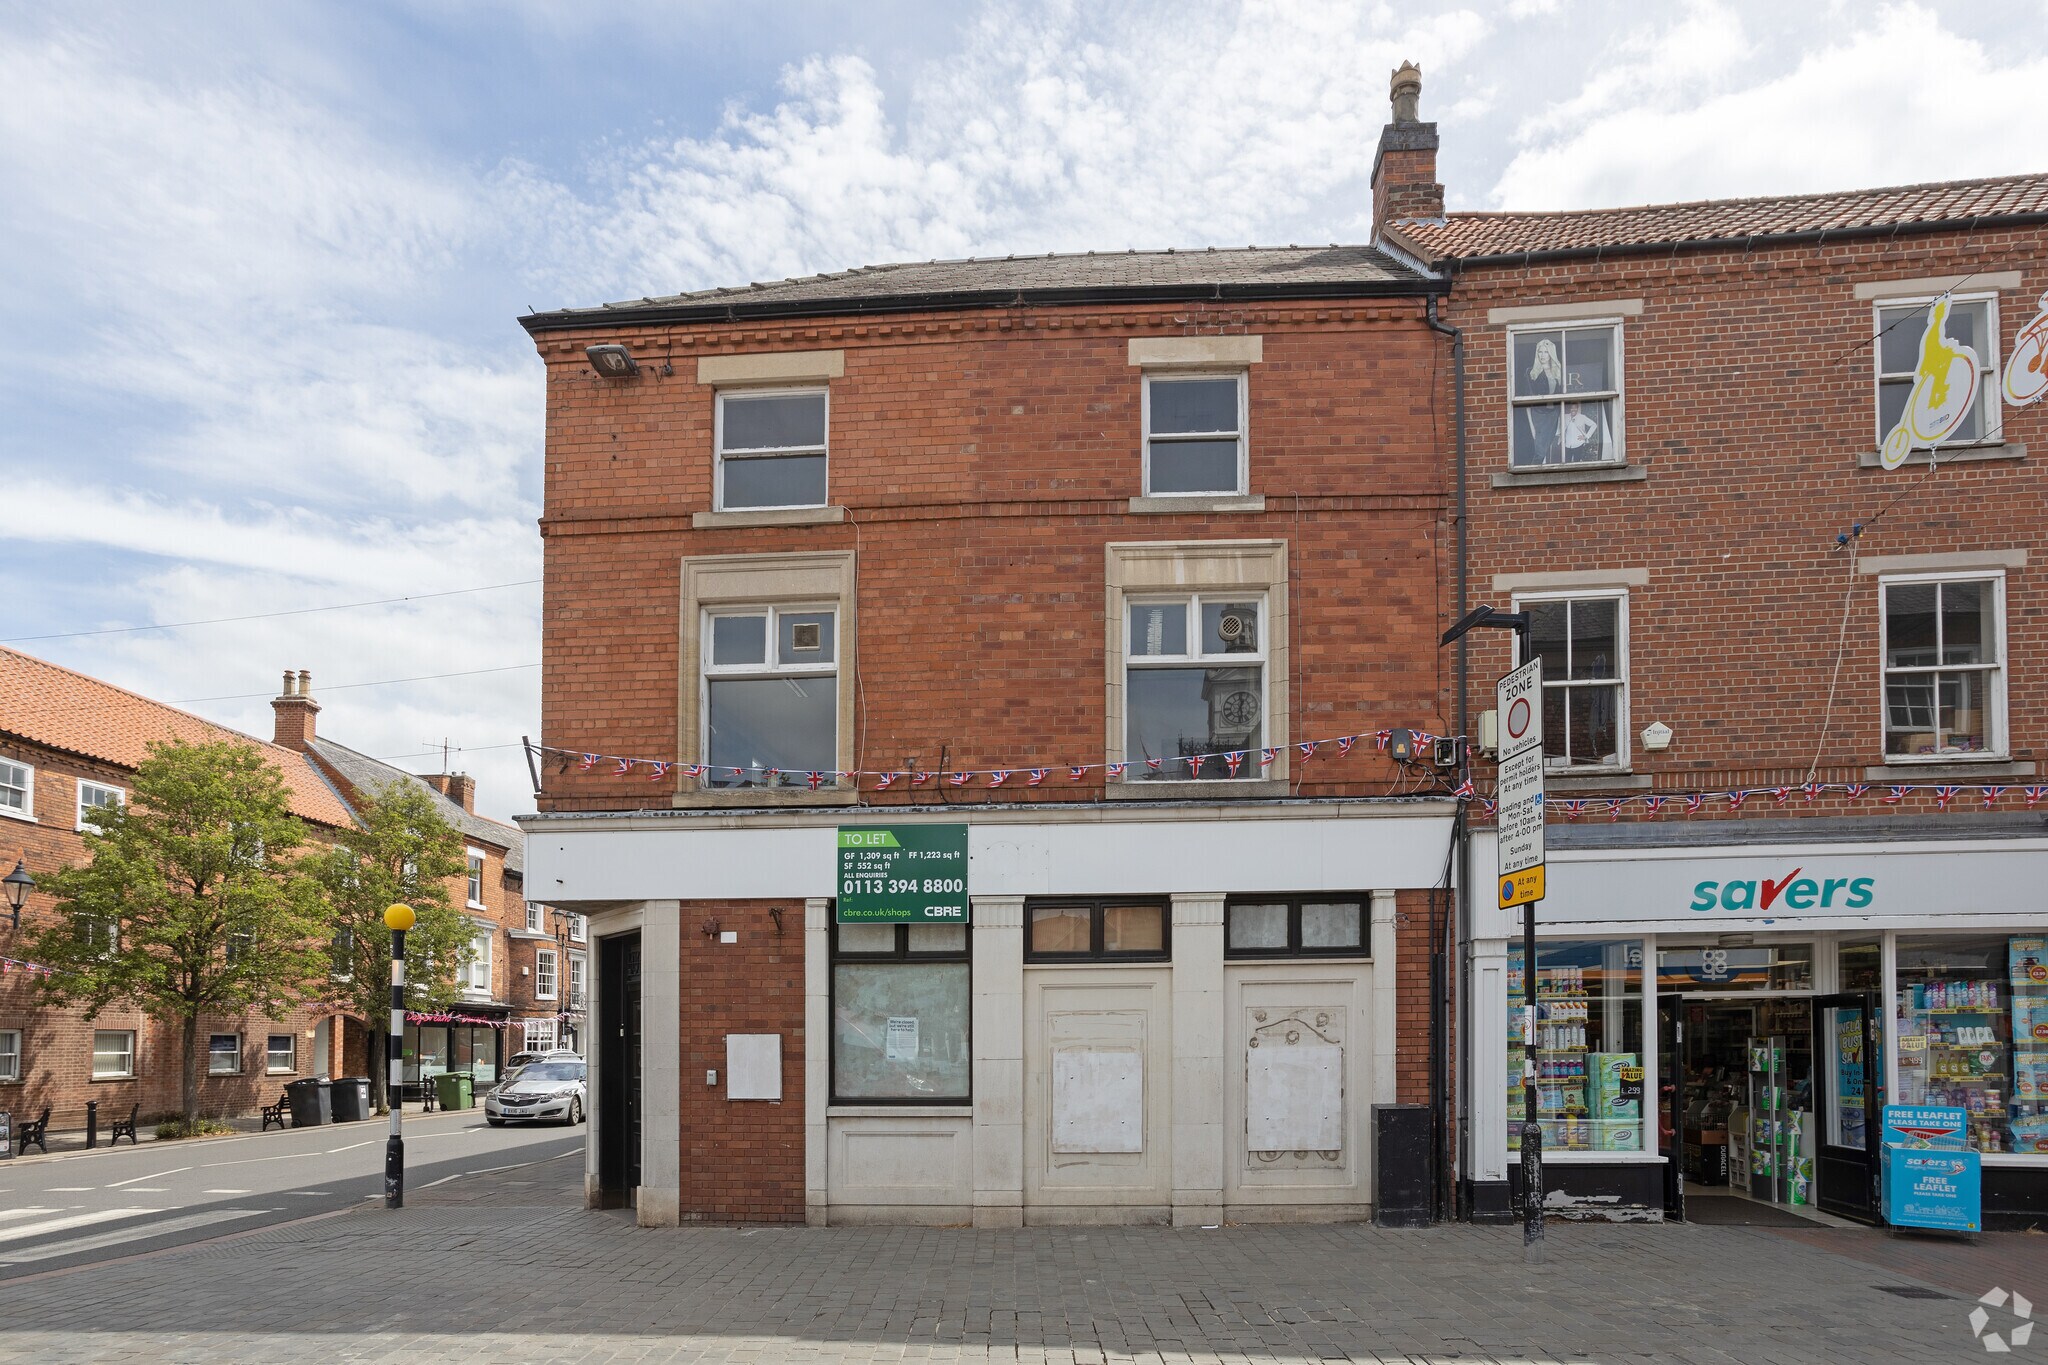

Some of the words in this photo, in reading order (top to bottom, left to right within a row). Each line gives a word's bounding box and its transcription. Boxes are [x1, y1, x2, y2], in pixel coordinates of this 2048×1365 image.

[1499, 661, 1538, 691] PEDESTRIAN
[1506, 676, 1532, 702] ZONE
[1502, 748, 1511, 756] No
[1512, 735, 1536, 752] vehicles
[1504, 760, 1523, 774] Except
[1525, 755, 1534, 764] for
[1500, 772, 1517, 786] permit
[1519, 763, 1540, 777] holders
[1504, 785, 1511, 793] At
[1512, 781, 1522, 790] any
[1524, 775, 1538, 785] time
[1500, 802, 1521, 815] Loading
[1523, 795, 1534, 805] and
[1508, 806, 1533, 821] Mon-Sat
[1500, 822, 1518, 834] before
[1519, 815, 1536, 826] 10am
[1537, 812, 1542, 820] &
[845, 834, 862, 845] TO
[867, 834, 886, 844] LET
[1500, 833, 1514, 844] after
[1532, 823, 1542, 832] pm
[860, 852, 880, 860] 1,309
[954, 851, 960, 859] ft
[1510, 842, 1532, 855] Sunday
[1504, 862, 1511, 870] At
[1513, 858, 1523, 868] any
[1525, 853, 1538, 864] time
[844, 880, 883, 894] 0113
[888, 880, 918, 894] 394
[923, 879, 963, 893] 8800
[1518, 878, 1524, 886] At
[1526, 875, 1537, 884] any
[1520, 889, 1534, 898] time
[1690, 867, 1875, 912] savers
[843, 908, 911, 917] cbre.co.uk/shops
[925, 906, 961, 917] CBRE
[1917, 1111, 1962, 1120] LEAFLET
[1907, 1158, 1947, 1167] savers
[1914, 1183, 1957, 1192] LEAFLET
